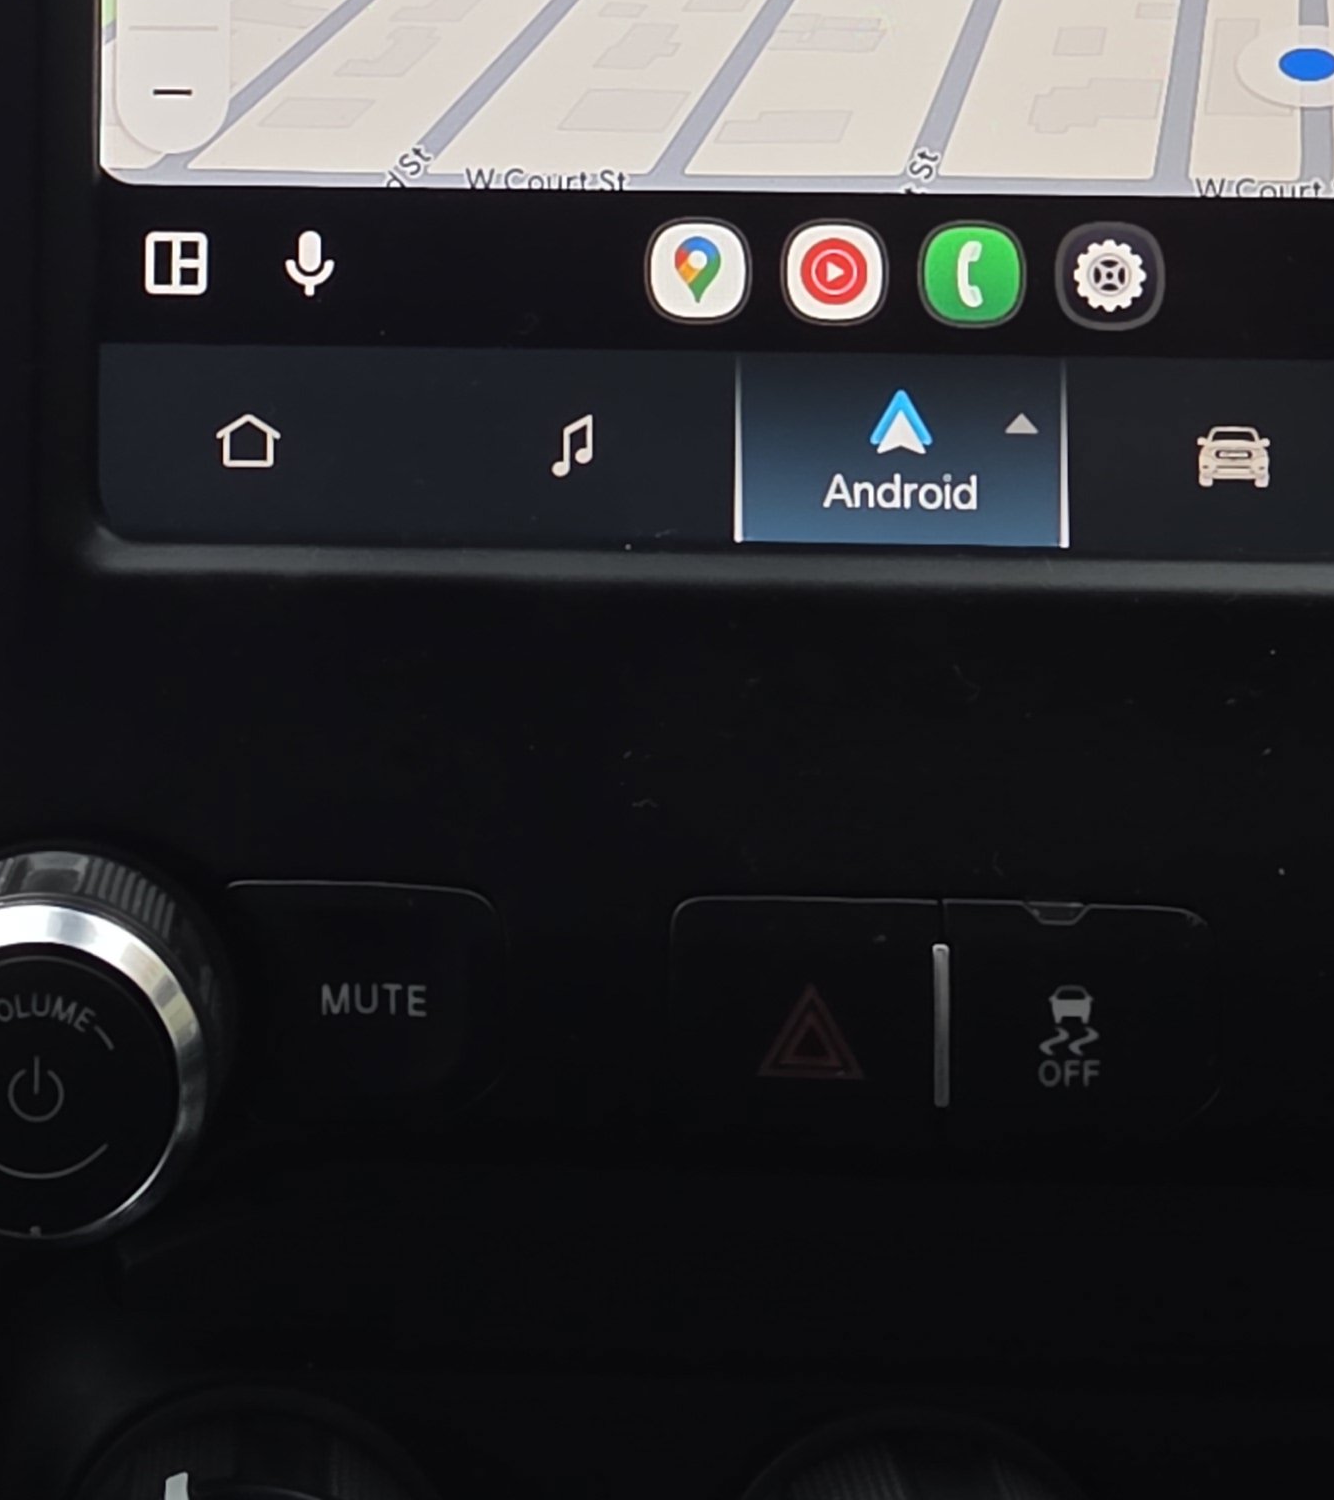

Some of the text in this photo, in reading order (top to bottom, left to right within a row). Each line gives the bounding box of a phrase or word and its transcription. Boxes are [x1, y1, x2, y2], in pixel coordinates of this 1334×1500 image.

[399, 147, 431, 176] St
[909, 152, 938, 179] St
[466, 168, 626, 190] W Court St
[1196, 178, 1225, 197] W
[823, 473, 978, 510] Android
[320, 983, 427, 1018] MUTE
[1038, 1060, 1100, 1087] OFF
